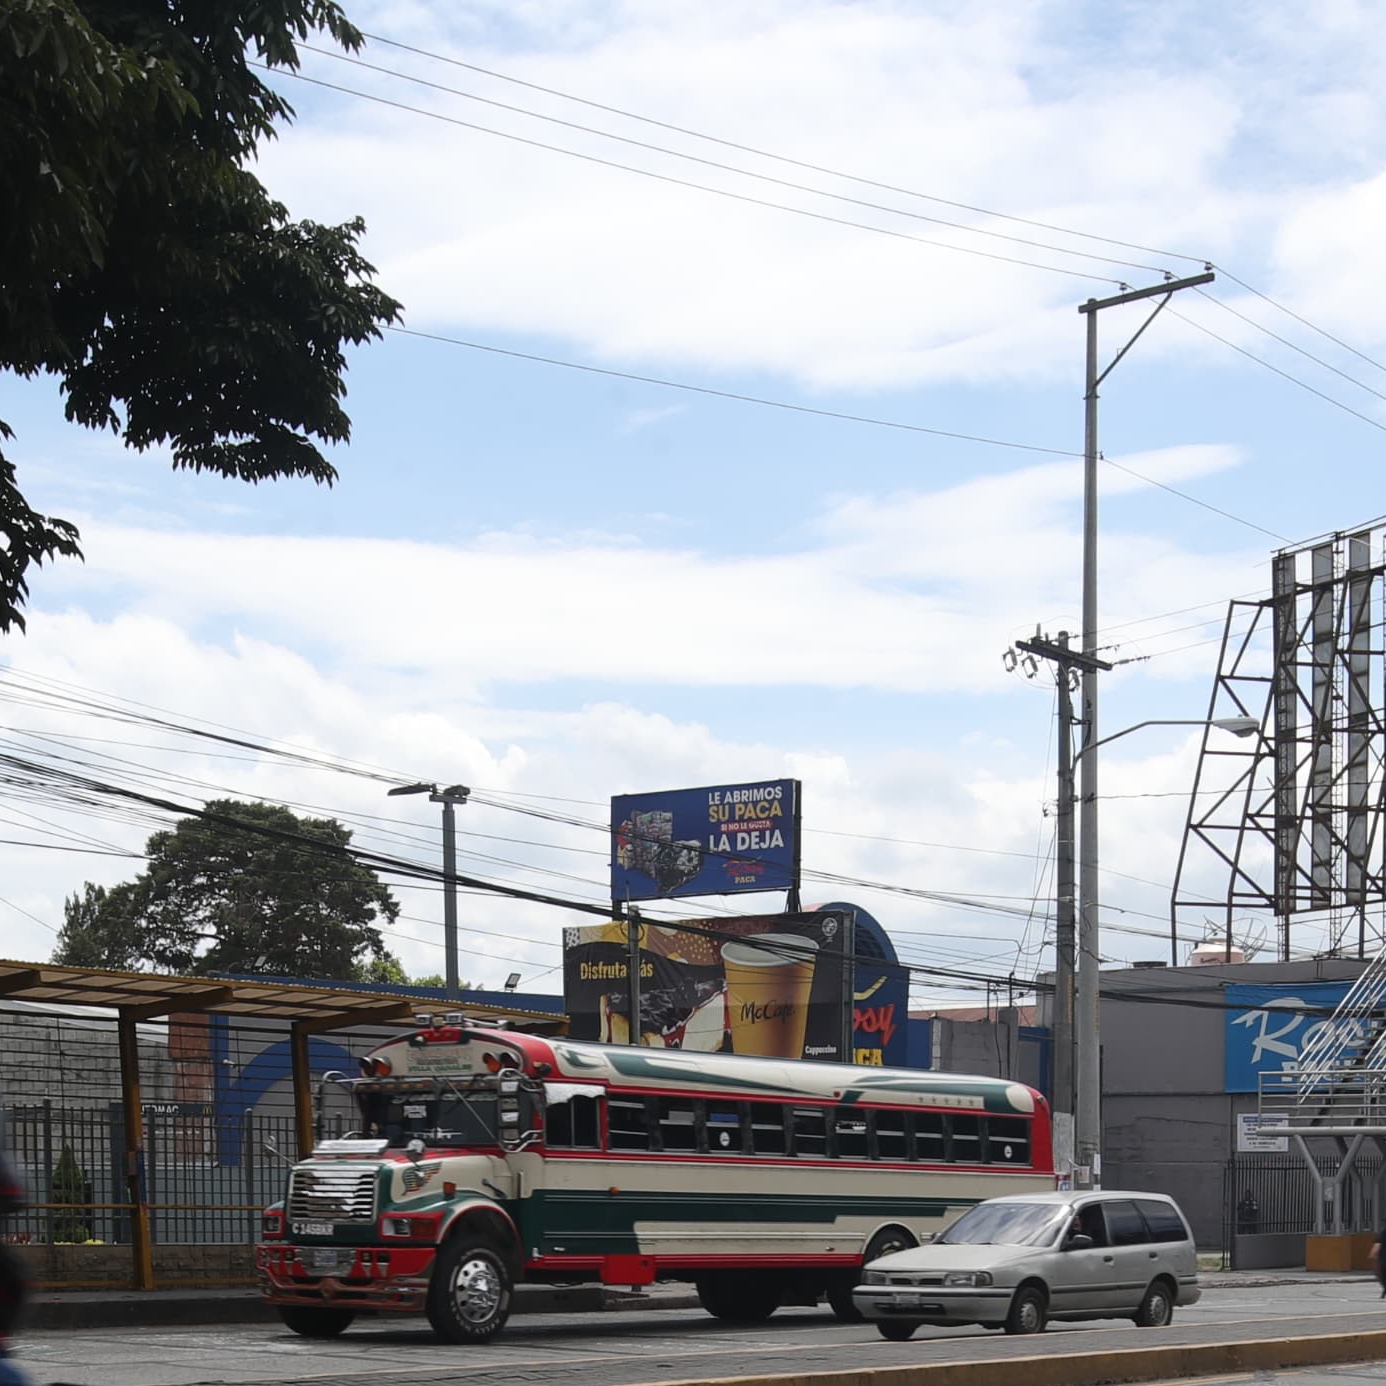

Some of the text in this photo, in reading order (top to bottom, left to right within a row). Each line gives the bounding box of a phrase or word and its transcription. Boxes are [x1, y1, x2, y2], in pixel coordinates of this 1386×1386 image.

[708, 786, 782, 806] LE ABRIMOS
[708, 800, 783, 823] SU PACA
[709, 829, 784, 853] LA DEJA
[580, 960, 628, 981] Disfruta
